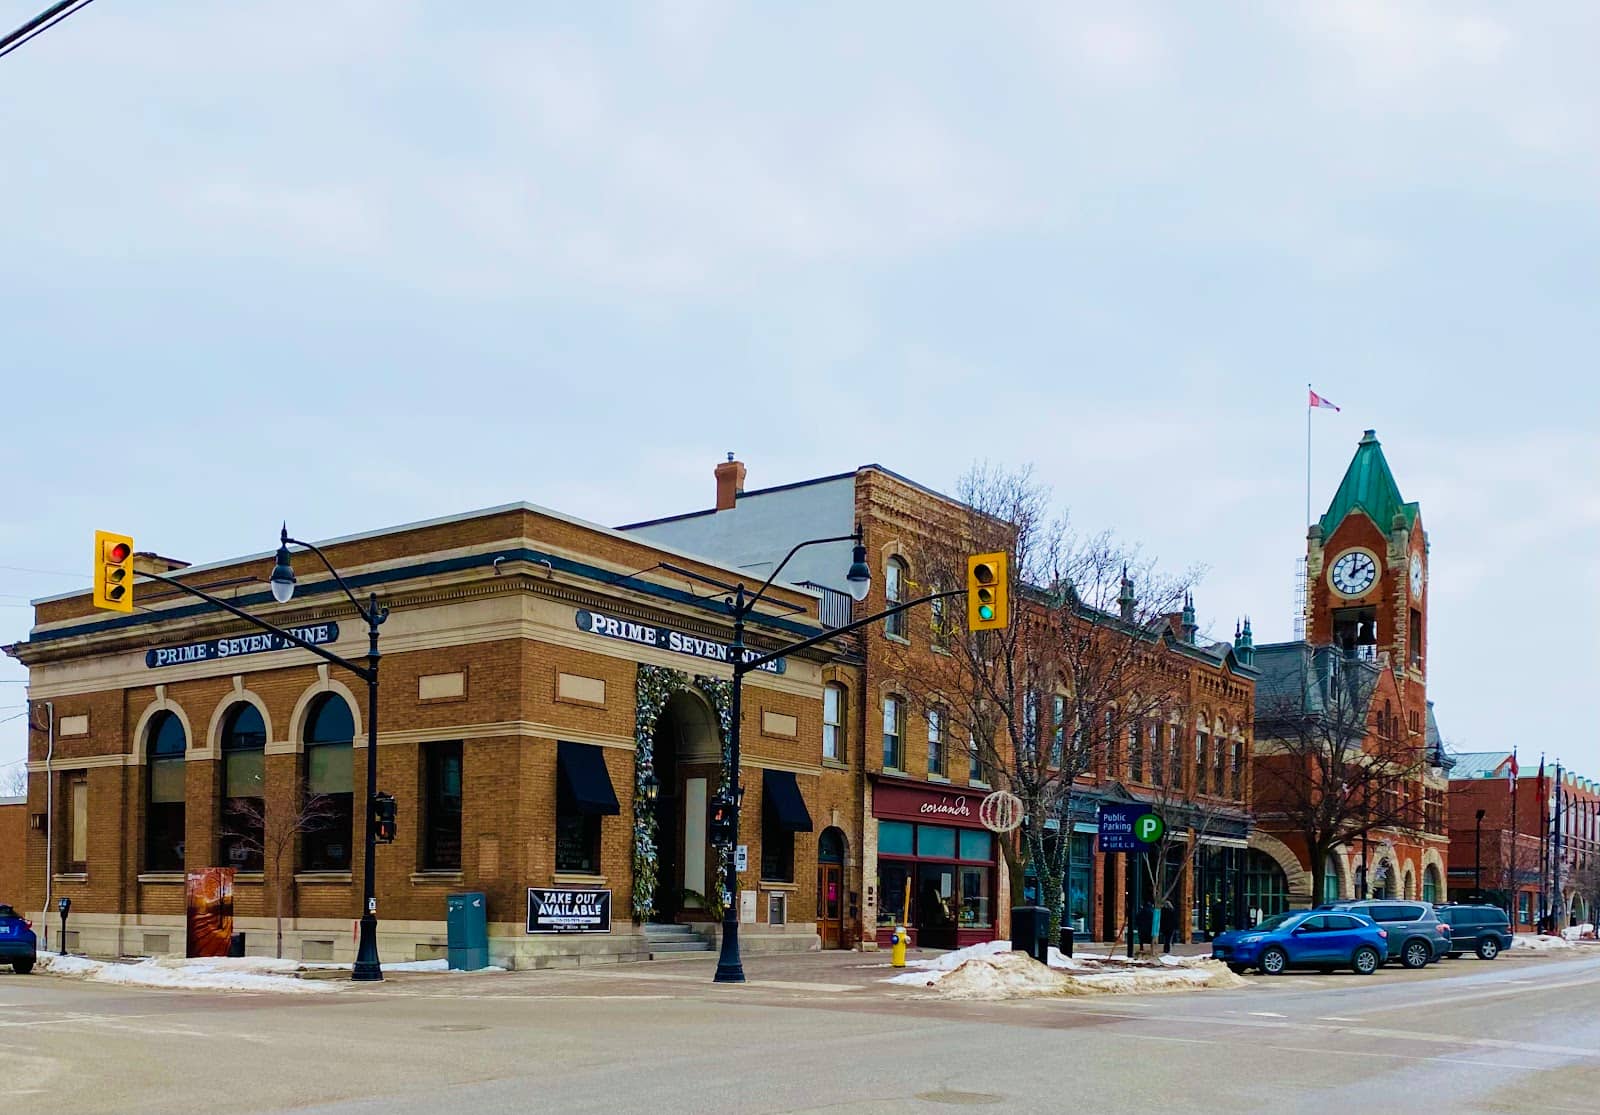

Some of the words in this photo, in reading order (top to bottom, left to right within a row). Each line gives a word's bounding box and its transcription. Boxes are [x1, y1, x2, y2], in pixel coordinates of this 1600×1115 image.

[588, 612, 656, 645] PRIME
[669, 632, 728, 661] SEVEN
[156, 643, 207, 666] PRIME
[217, 634, 272, 657] SEVEN
[920, 796, 970, 816] coriander
[1103, 813, 1126, 822] Public
[1103, 823, 1132, 832] Parking
[1143, 819, 1157, 838] P
[543, 892, 572, 904] TAKE
[575, 893, 597, 904] OUT
[538, 904, 602, 915] AVAILABLE
